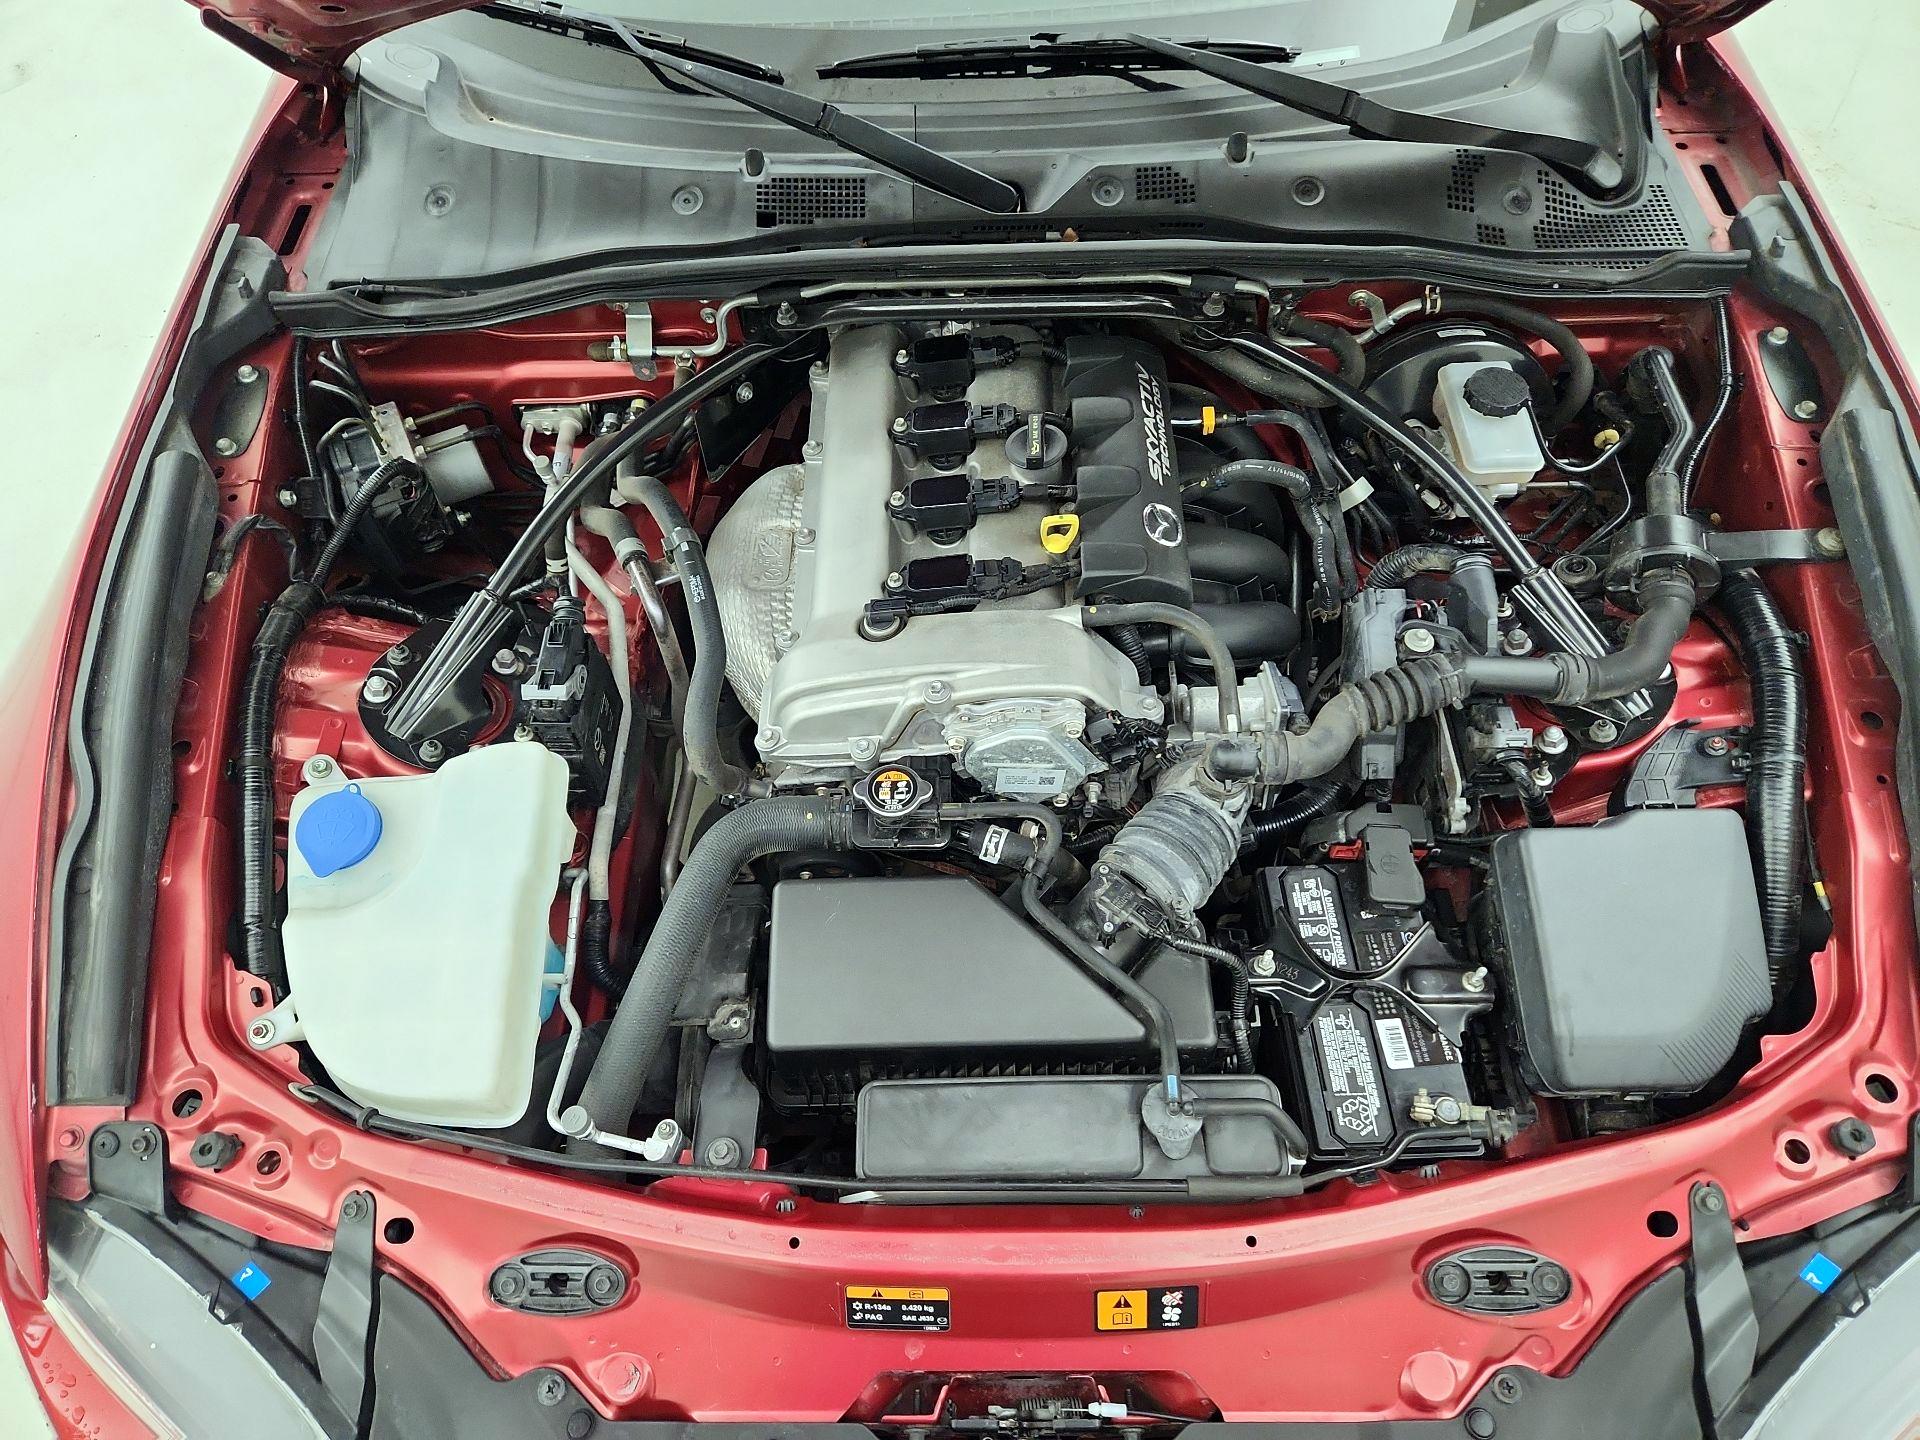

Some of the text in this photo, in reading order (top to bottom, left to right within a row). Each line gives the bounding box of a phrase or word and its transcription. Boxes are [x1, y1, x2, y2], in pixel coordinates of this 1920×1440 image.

[1135, 360, 1164, 486] SKYACTIV
[1151, 375, 1171, 478] TECHNOLOGY
[864, 1303, 892, 1311] R-134a
[923, 1305, 935, 1313] kg
